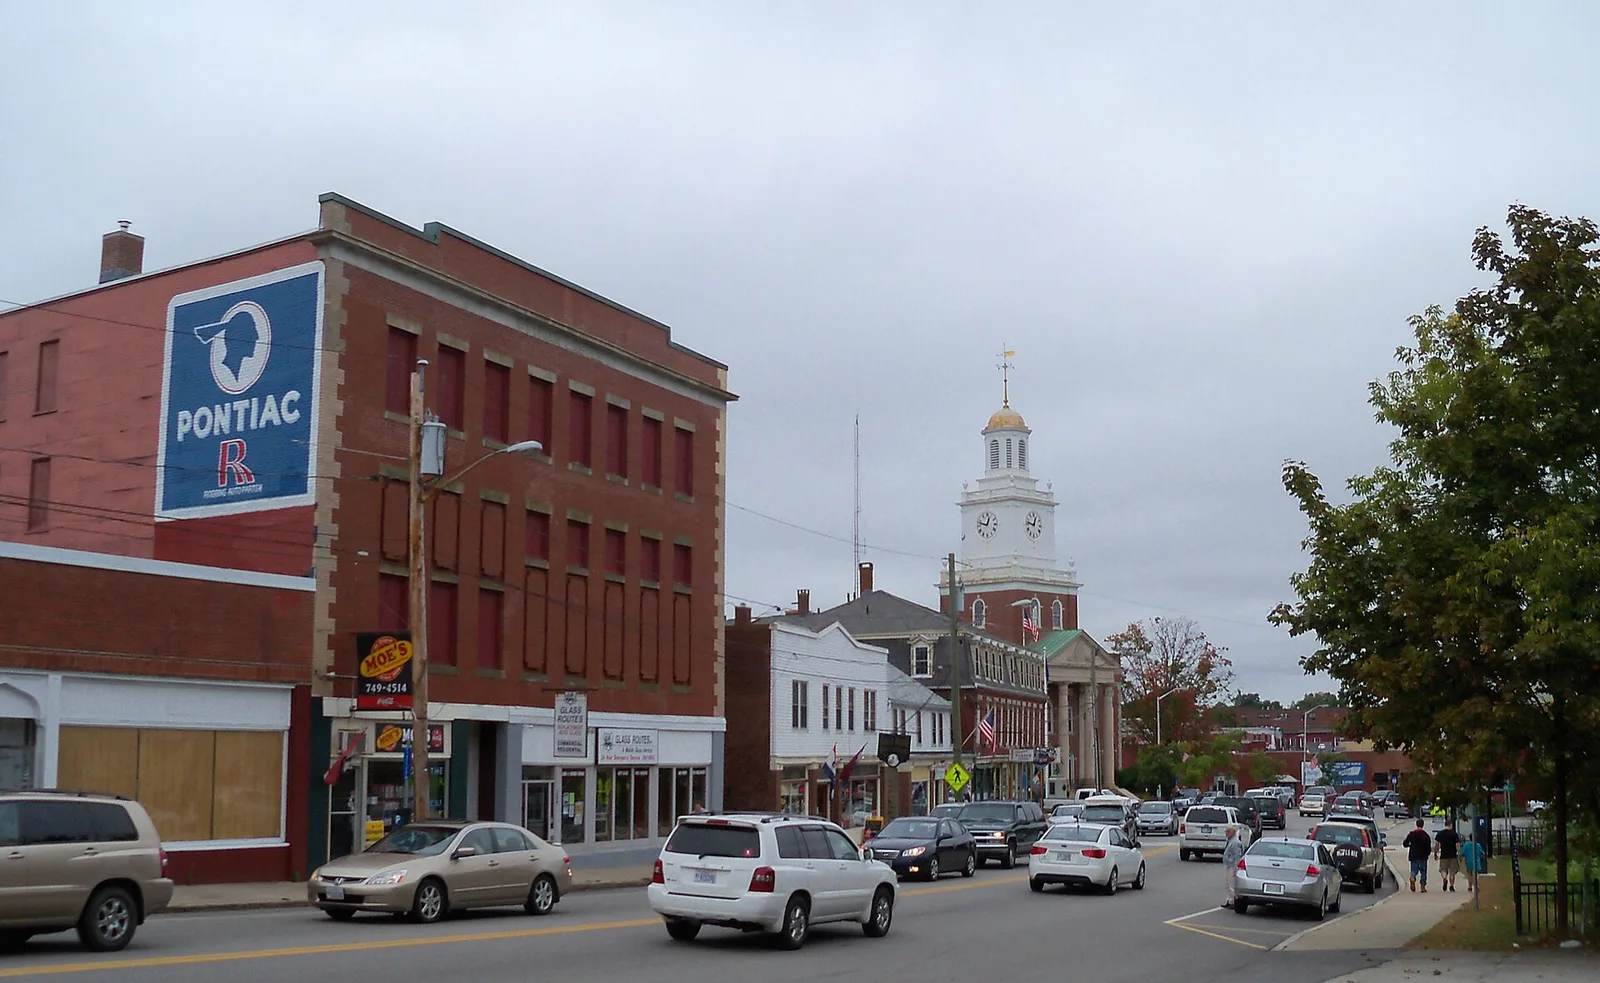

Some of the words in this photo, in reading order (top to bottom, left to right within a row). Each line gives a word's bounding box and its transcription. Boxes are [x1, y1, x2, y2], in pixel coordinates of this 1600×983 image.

[176, 390, 301, 442] PONTIAC
[365, 642, 408, 673] MOE'S
[365, 683, 407, 693] 749-4514
[560, 706, 582, 714] GLASS
[557, 715, 584, 723] ROUTES
[1479, 818, 1485, 826] P
